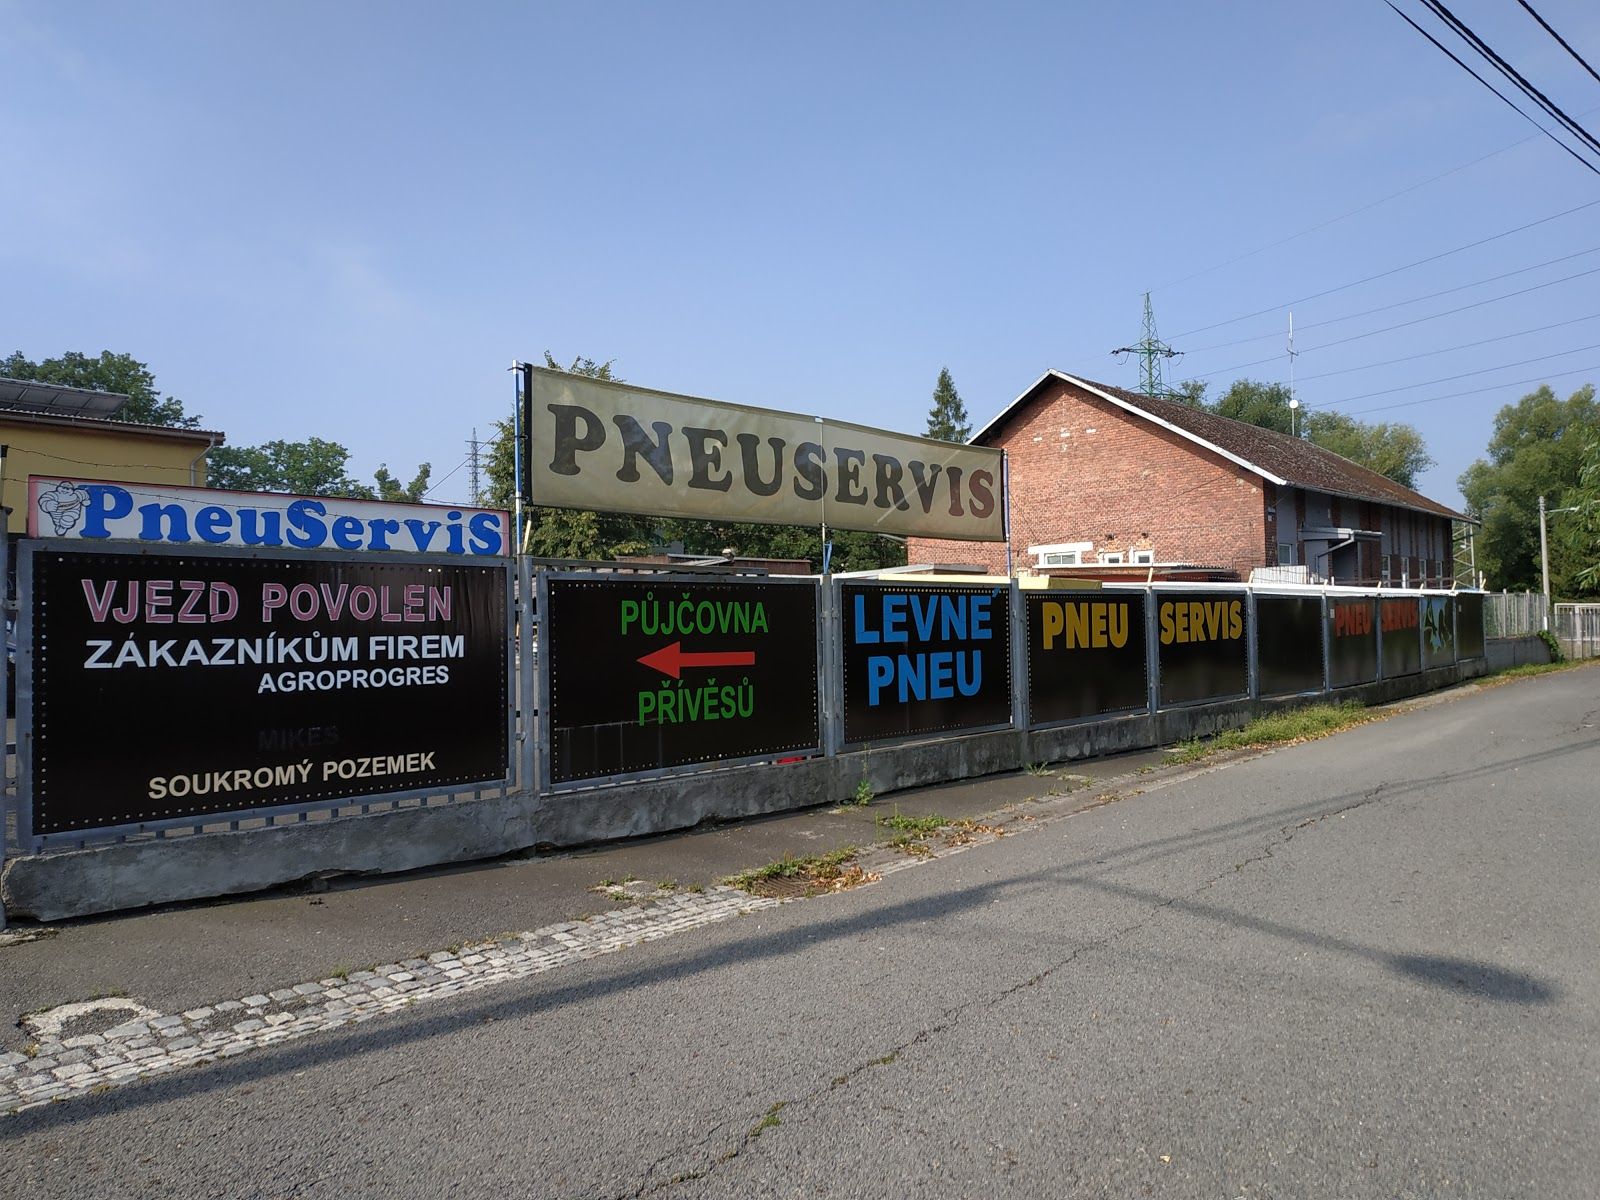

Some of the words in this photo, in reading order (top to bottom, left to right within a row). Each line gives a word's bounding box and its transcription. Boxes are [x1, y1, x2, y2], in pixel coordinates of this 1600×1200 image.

[547, 403, 995, 519] PNEUSERVIS
[80, 578, 240, 624] VJEZD
[261, 582, 452, 623] POVOLEN
[620, 591, 769, 636] PŮJČOVNA
[853, 588, 1001, 644] LEVNÉ
[1042, 602, 1129, 650] PNEU
[1159, 600, 1243, 645] SERVIS
[1335, 604, 1371, 637] PNEU
[83, 629, 359, 670] ZÁKAZNÍKŮM
[369, 635, 465, 661] FIREM
[257, 665, 450, 694] AGROPROGRES
[638, 676, 755, 727] PŘÍVĚSŮ
[867, 650, 983, 706] PNEU
[148, 758, 314, 800] SOUKROMÝ
[322, 751, 436, 781] POZEMEK
